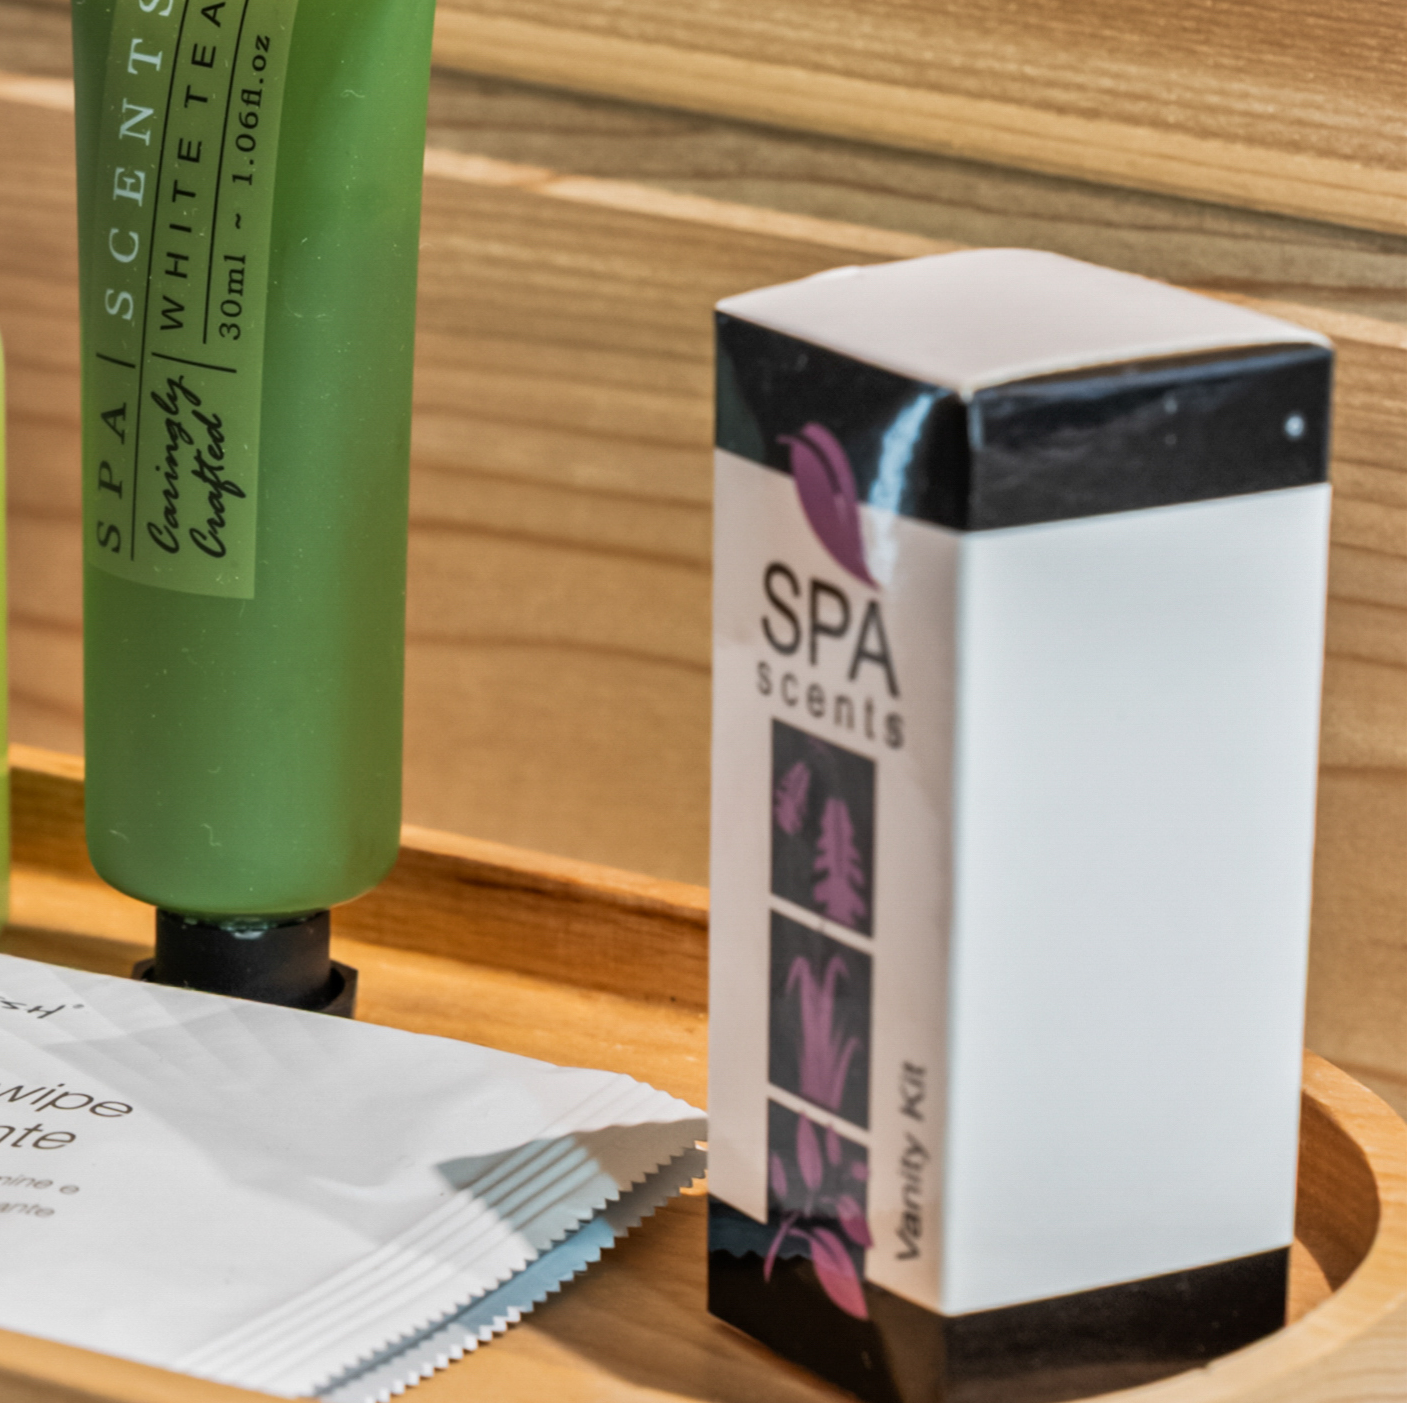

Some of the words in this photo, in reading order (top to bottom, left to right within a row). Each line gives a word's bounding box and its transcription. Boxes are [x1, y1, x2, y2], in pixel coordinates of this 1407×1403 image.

[160, 138, 202, 331] WHITE
[184, 1, 227, 108] TEA
[232, 34, 270, 187] 1.06fl.oz
[219, 253, 246, 341] 30ml
[97, 402, 127, 554] SPA
[147, 375, 201, 554] Caringly
[189, 409, 247, 559] Crafted
[761, 562, 901, 699] SPA
[757, 660, 905, 750] scents
[899, 1061, 926, 1121] Kit
[895, 1131, 930, 1261] Vanity
